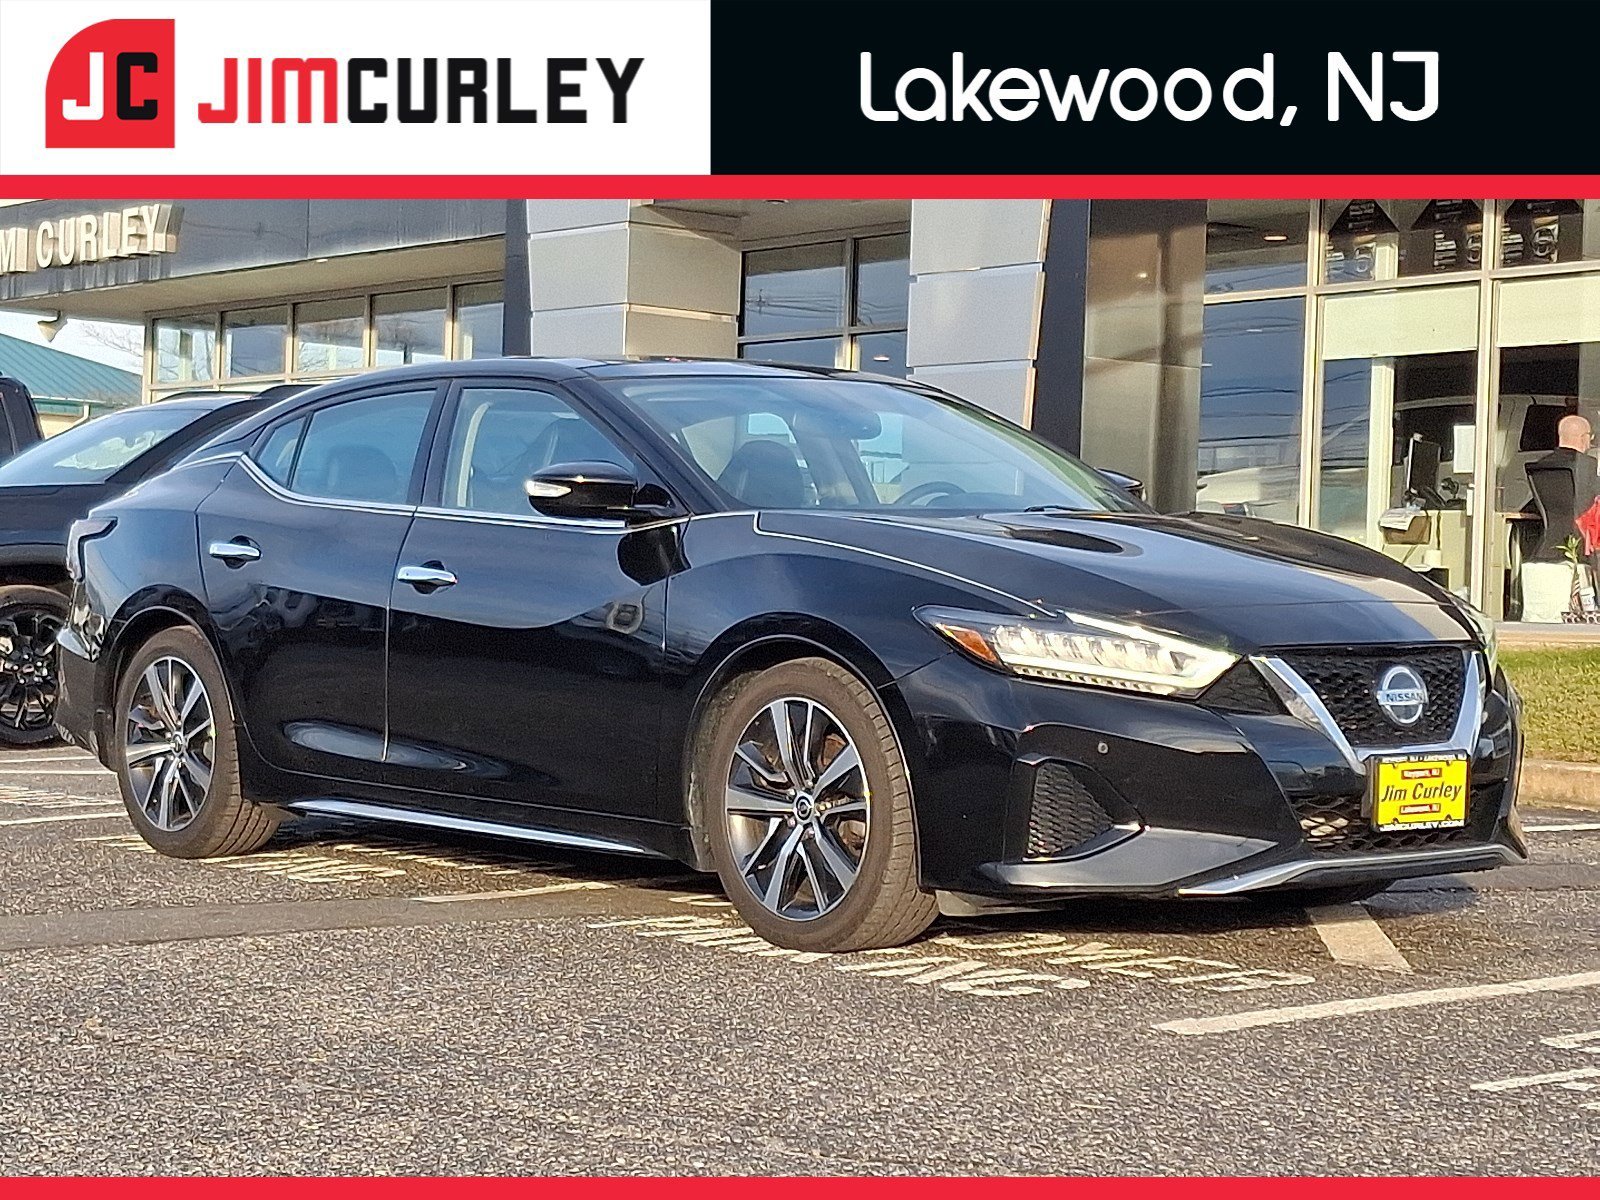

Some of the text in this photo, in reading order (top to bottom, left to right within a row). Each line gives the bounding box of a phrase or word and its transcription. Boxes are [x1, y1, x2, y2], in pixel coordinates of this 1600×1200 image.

[36, 204, 176, 269] CURLEY
[1385, 692, 1423, 702] NISSAN
[1381, 781, 1462, 802] Jim Curley
